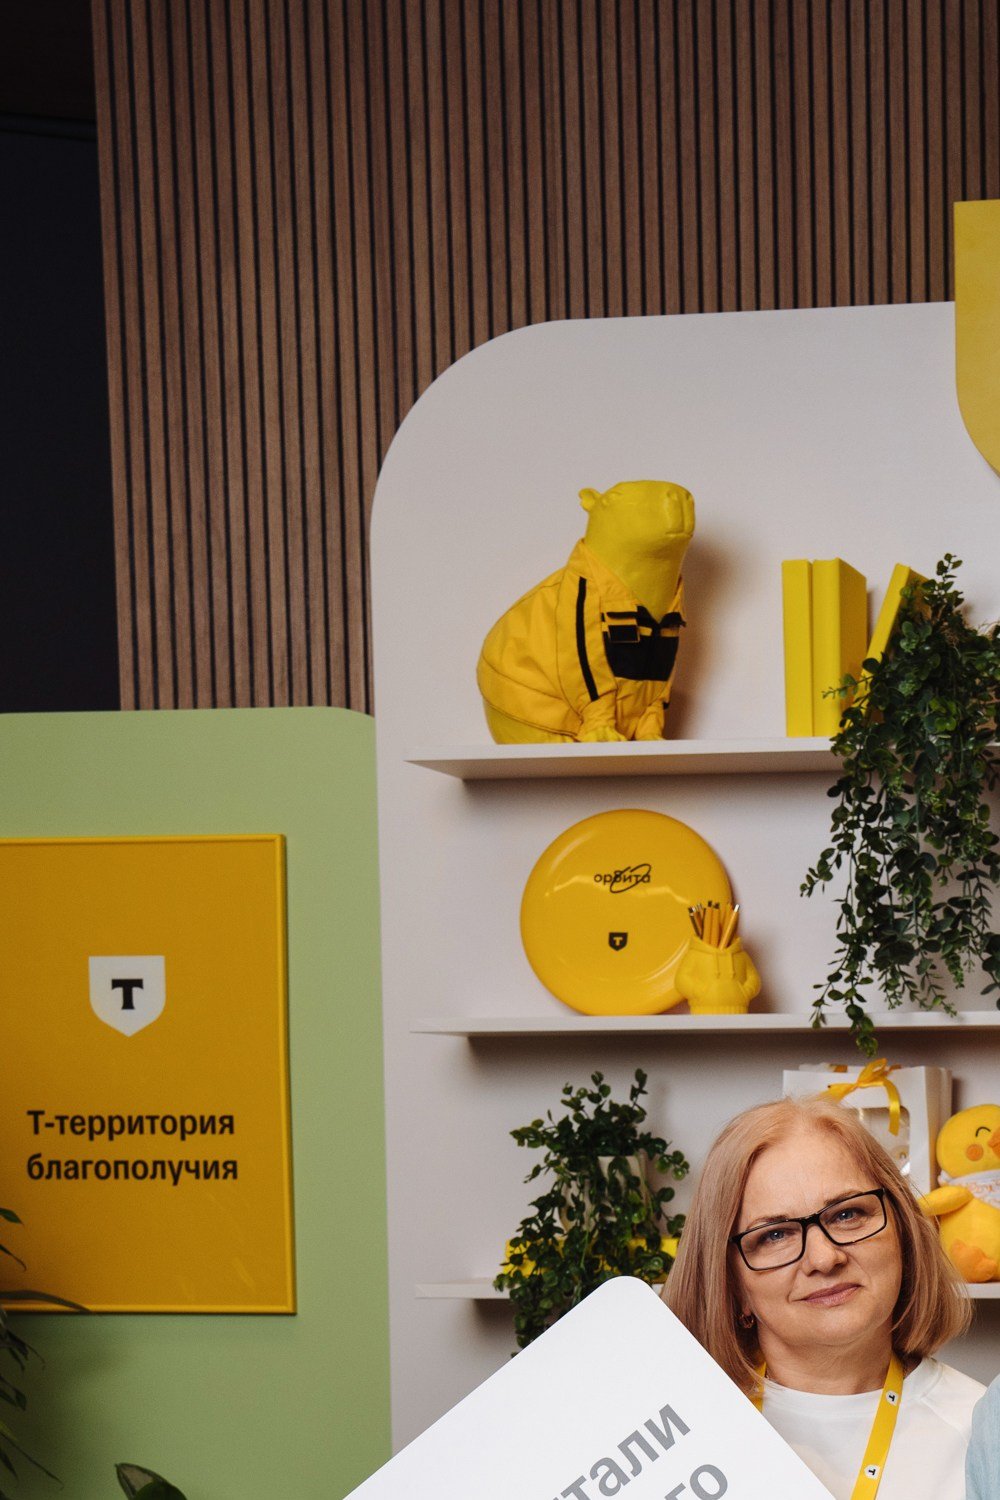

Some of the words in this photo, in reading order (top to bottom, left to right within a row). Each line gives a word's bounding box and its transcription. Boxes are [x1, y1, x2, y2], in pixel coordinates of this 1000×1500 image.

[593, 869, 651, 886] орбита
[111, 978, 144, 1010] Т
[26, 1109, 236, 1142] Т-территория
[26, 1152, 239, 1187] благополучия
